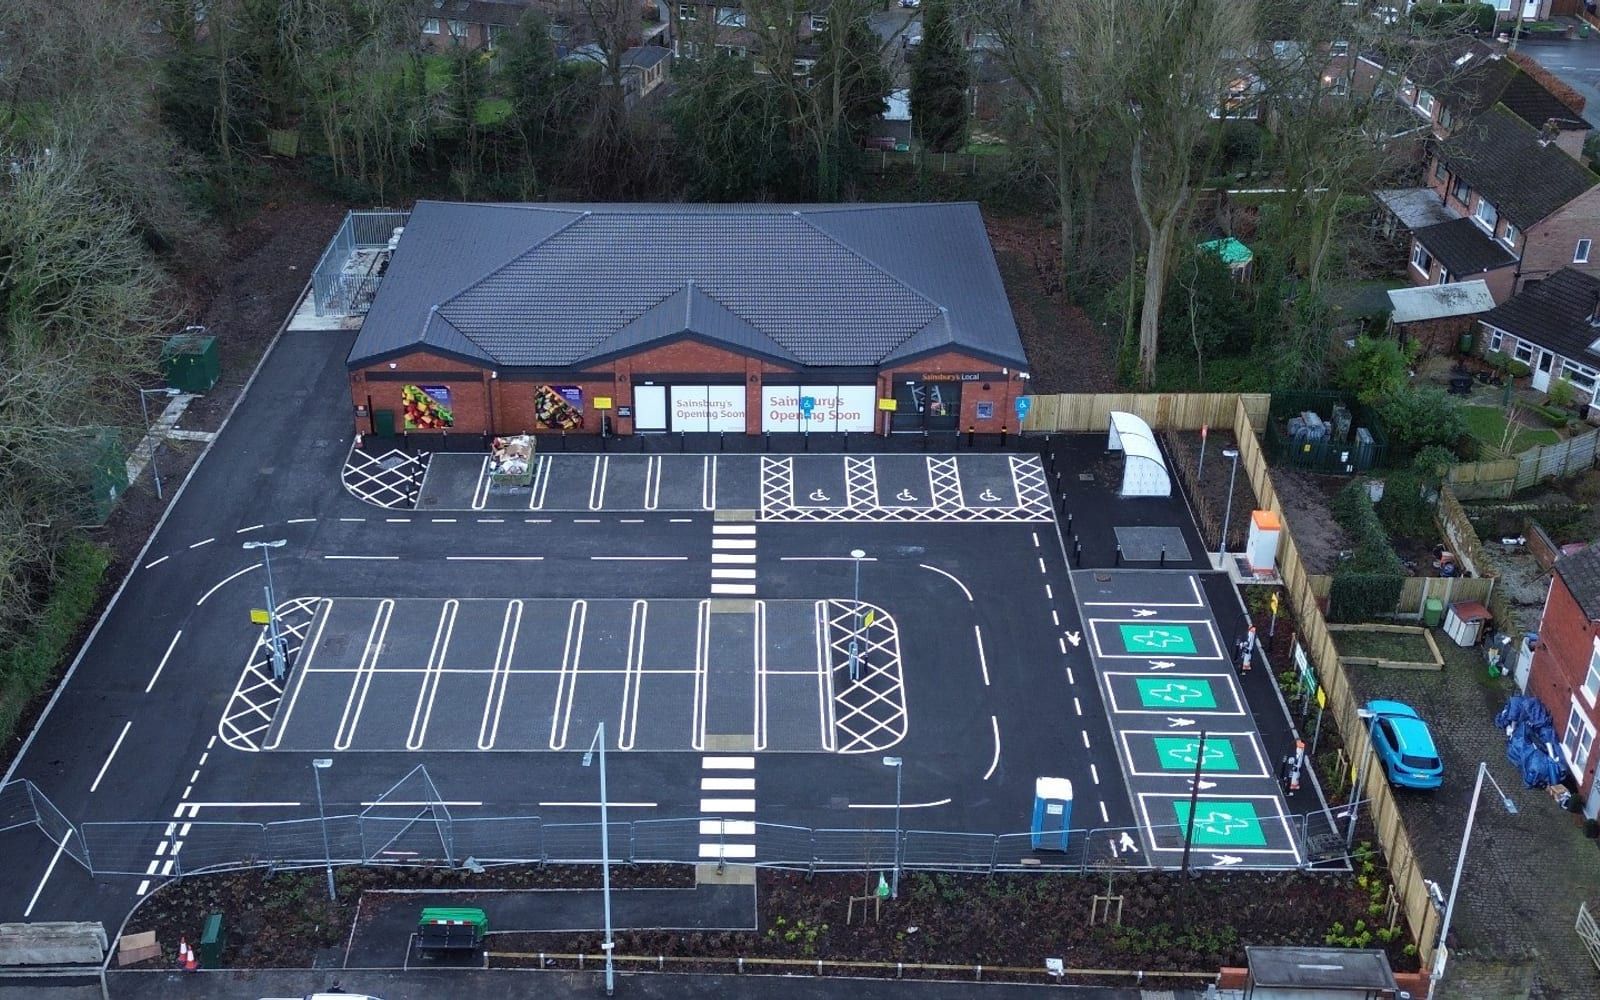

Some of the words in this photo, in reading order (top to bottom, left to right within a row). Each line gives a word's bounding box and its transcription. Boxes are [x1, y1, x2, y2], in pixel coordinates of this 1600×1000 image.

[961, 373, 980, 381] Local
[676, 399, 733, 409] Sainsbury's
[770, 396, 844, 408] Sainury's
[676, 410, 718, 420] Opening
[720, 410, 745, 418] Soon
[769, 410, 825, 422] Openng
[828, 410, 861, 420] Soon
